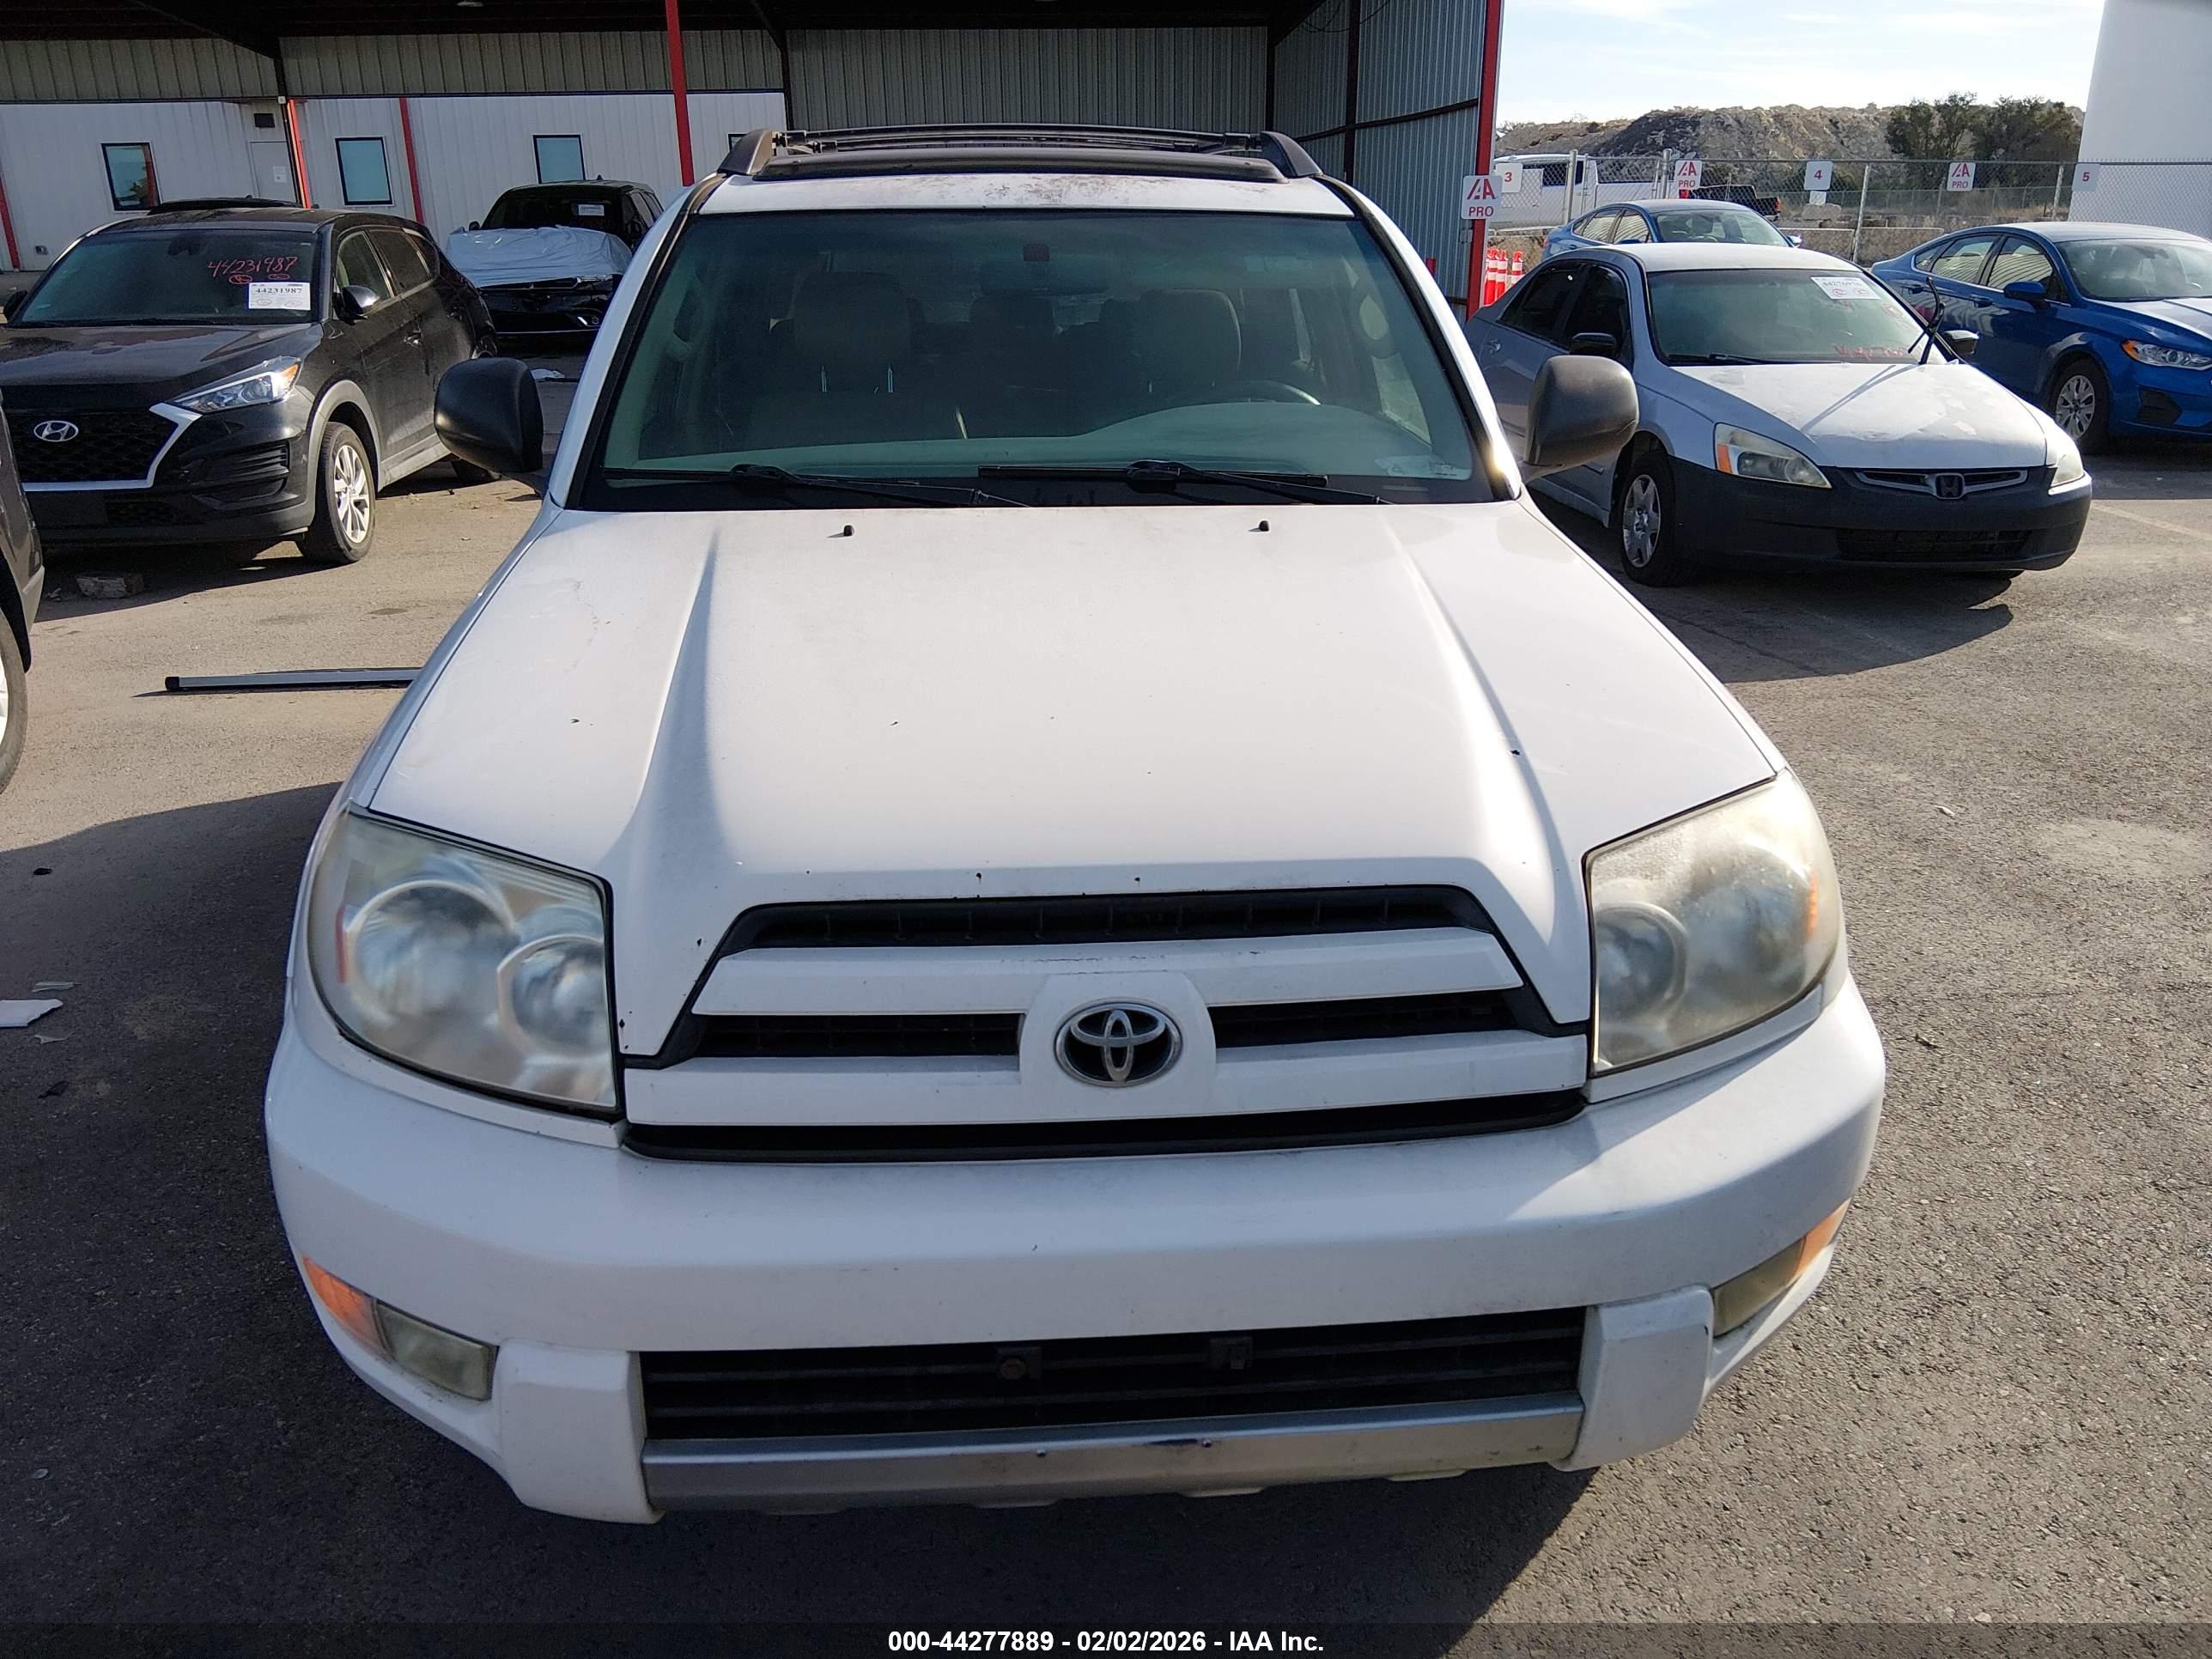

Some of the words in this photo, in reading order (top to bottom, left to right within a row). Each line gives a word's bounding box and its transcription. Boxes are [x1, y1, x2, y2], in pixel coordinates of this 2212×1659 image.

[1504, 172, 1512, 182] 3
[1814, 169, 1822, 179] 4
[2082, 172, 2090, 181] 5
[1678, 179, 1696, 188] PRO
[1951, 180, 1968, 189] PRO
[1468, 205, 1494, 217] PRO
[207, 257, 298, 277] 44231987
